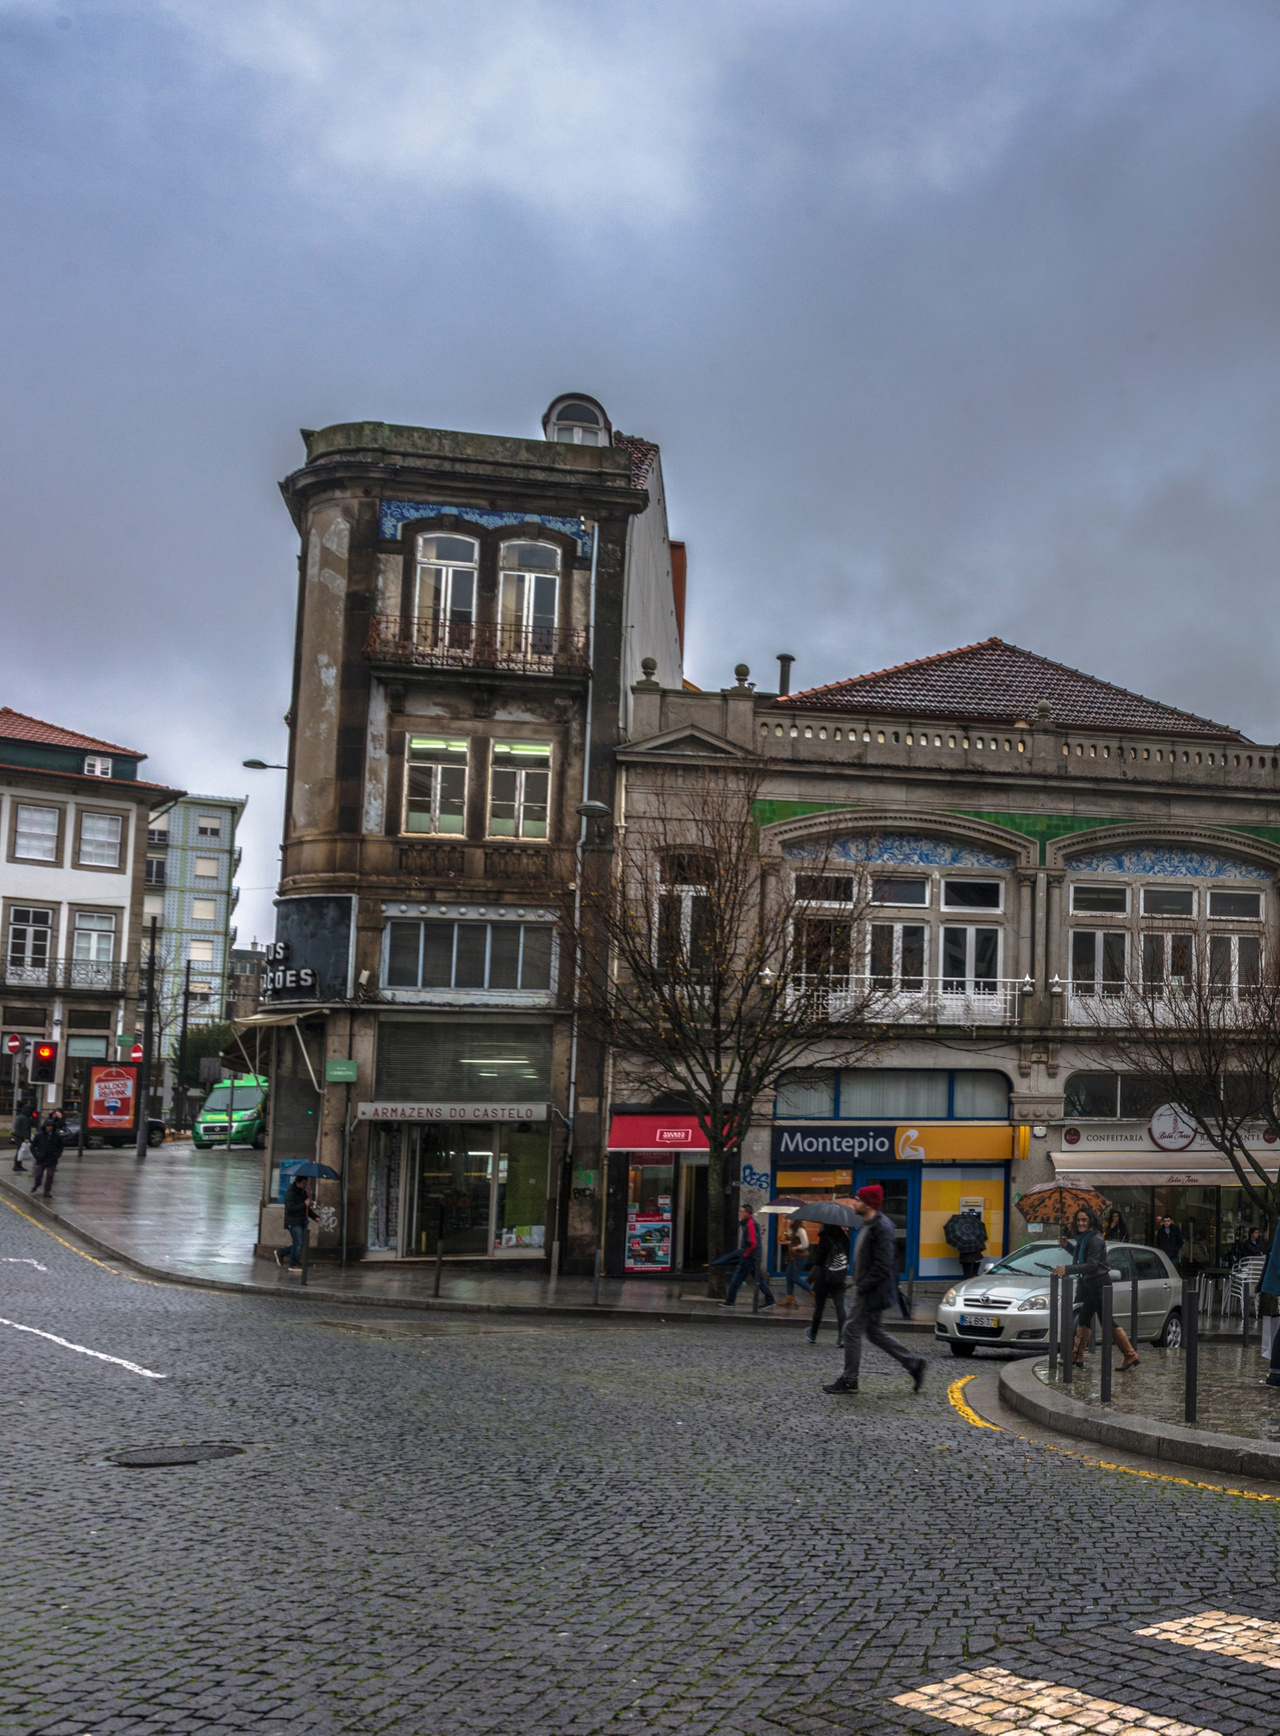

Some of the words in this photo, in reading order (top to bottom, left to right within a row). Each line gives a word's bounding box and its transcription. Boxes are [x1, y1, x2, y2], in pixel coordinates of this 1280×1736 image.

[372, 1107, 443, 1118] ARMAZENS
[449, 1108, 466, 1119] DO
[473, 1108, 533, 1119] CASTELO
[1086, 1134, 1144, 1142] CONFEITARIA
[779, 1132, 889, 1157] Montepio
